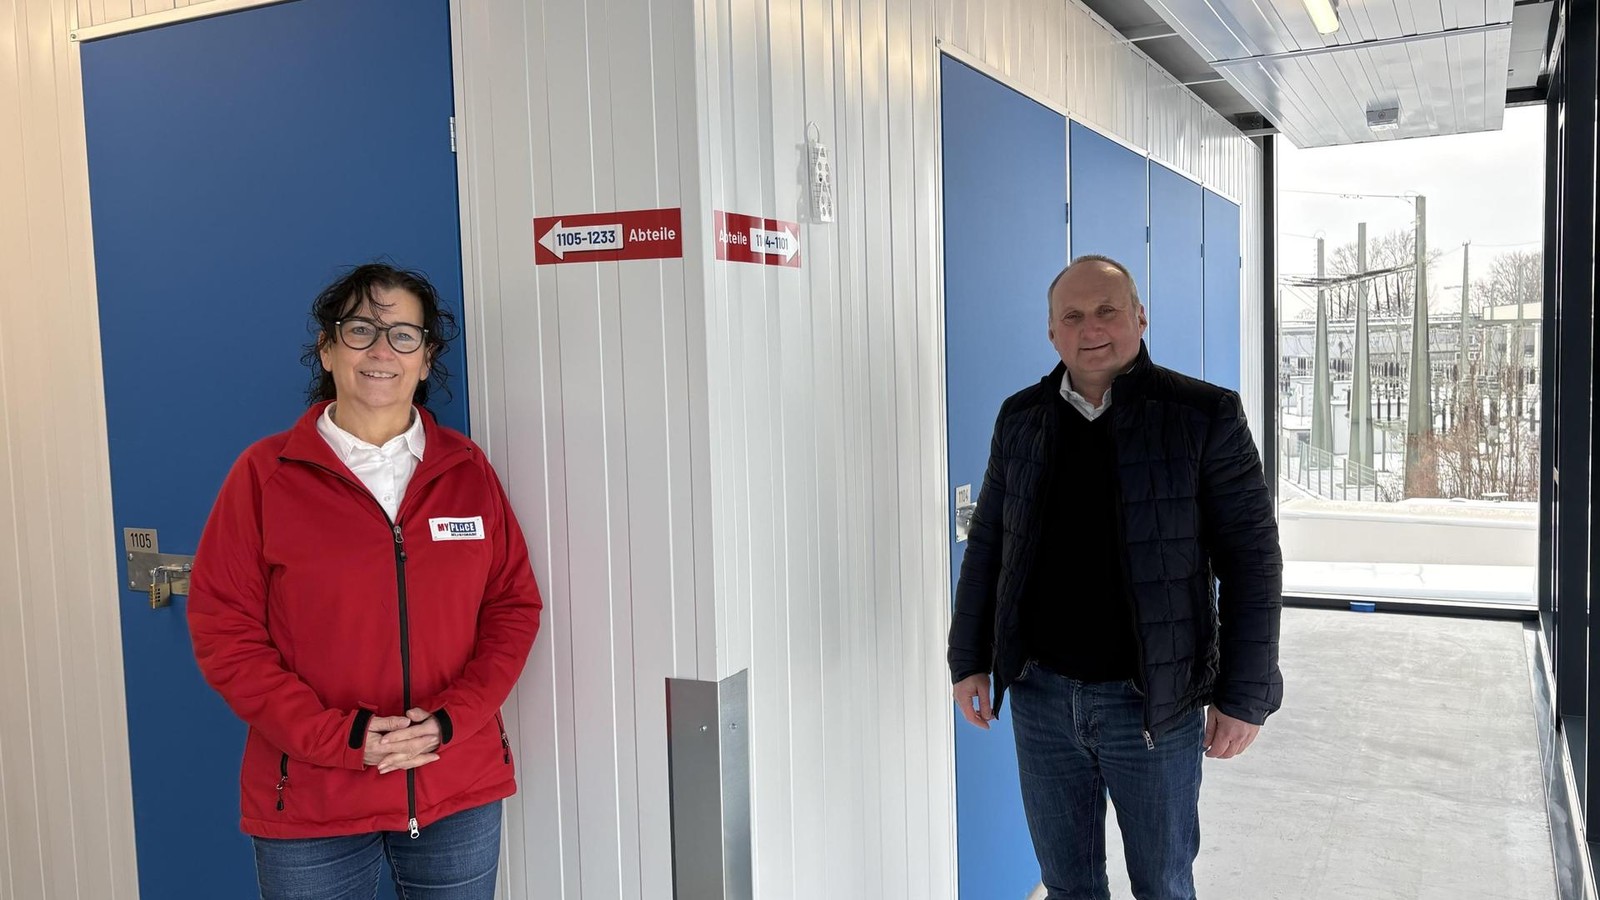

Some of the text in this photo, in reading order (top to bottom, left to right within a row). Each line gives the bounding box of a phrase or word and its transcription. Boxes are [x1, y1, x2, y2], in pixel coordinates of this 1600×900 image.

[557, 226, 676, 247] 1105-1233 Abteile
[756, 233, 788, 250] 114-1101
[130, 533, 152, 548] 1105
